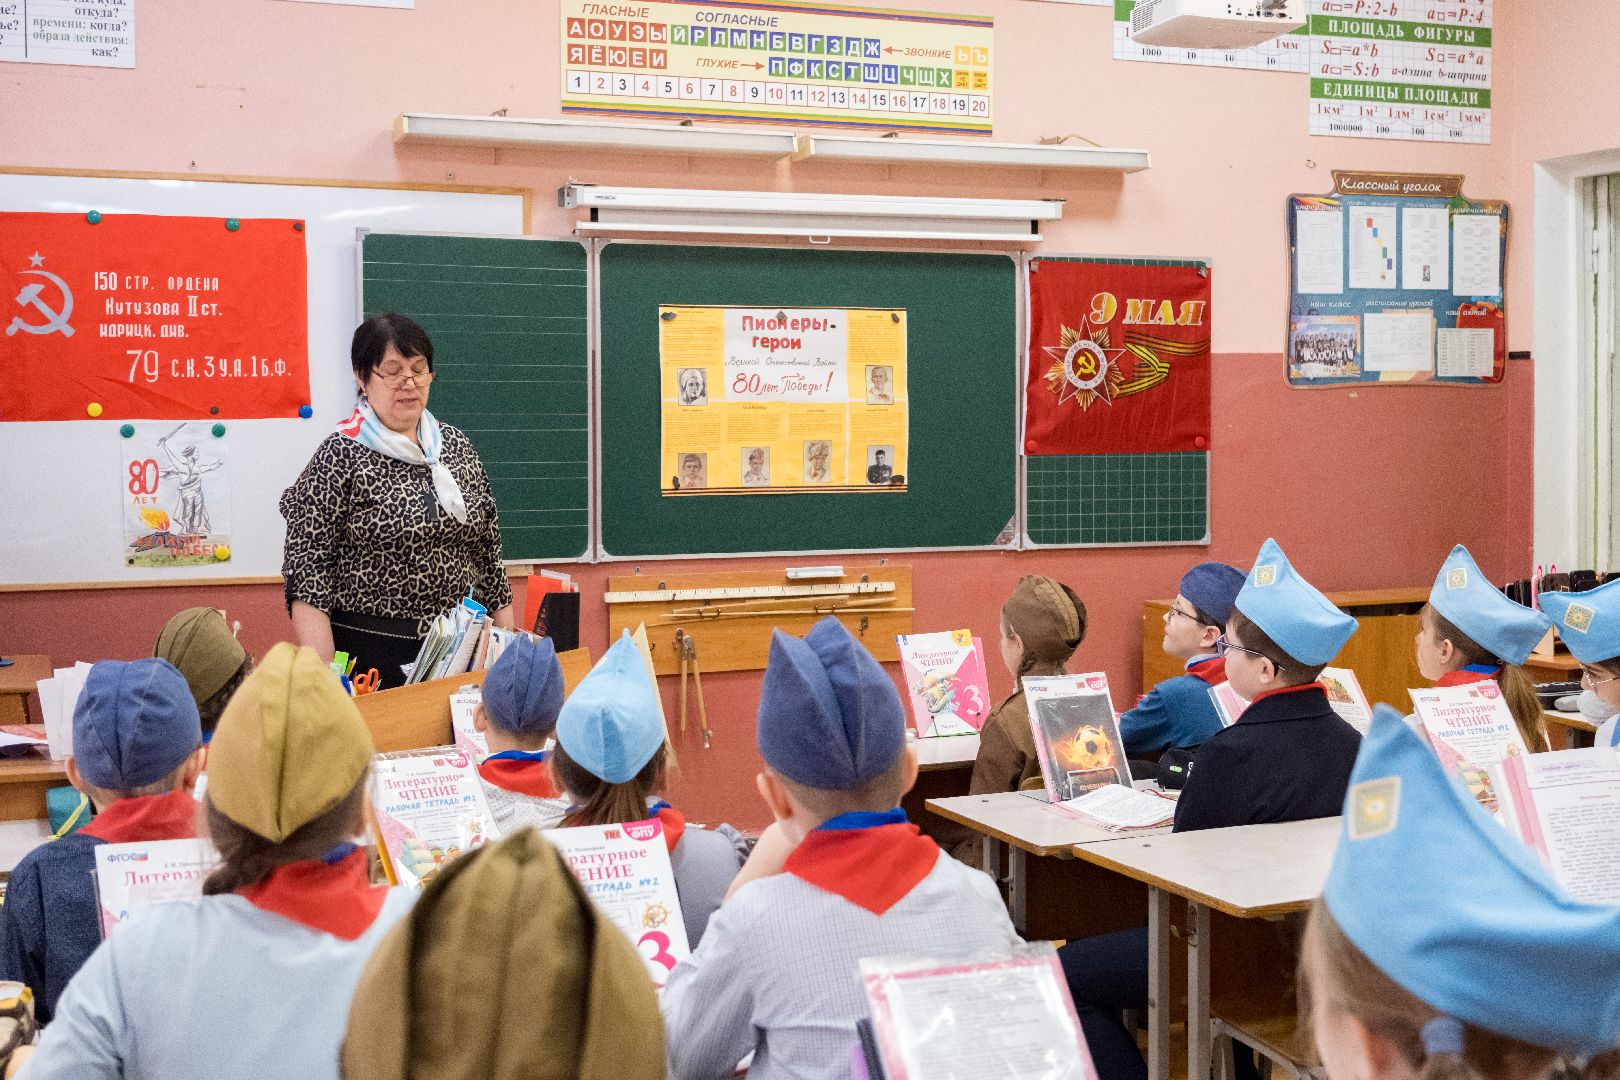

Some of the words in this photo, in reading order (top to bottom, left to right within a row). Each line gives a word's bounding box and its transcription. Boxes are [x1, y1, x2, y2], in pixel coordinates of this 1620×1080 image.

[75, 8, 119, 19] откуда?
[582, 4, 649, 18] ГЛАСНЫЕ
[33, 19, 86, 29] времени:
[90, 22, 128, 33] когда?
[696, 12, 778, 27] СОГЛАСНЫЕ
[33, 30, 70, 43] образа
[73, 35, 128, 45] действия:
[1328, 19, 1404, 38] ПЛОЩАДЬ
[1414, 27, 1475, 43] ФИГУРЫ
[92, 47, 119, 58] как?
[904, 47, 951, 59] ЗВОНКИЕ
[1142, 48, 1162, 56] 1000
[1224, 54, 1234, 62] 10
[1266, 57, 1276, 65] 10
[696, 58, 739, 69] ГЛУХИЕ
[575, 77, 581, 87] 1
[597, 78, 605, 89] 2
[619, 79, 627, 90] 3
[642, 81, 649, 92] 4
[664, 82, 672, 93] 5
[686, 83, 693, 94] 6
[709, 84, 716, 95] 7
[730, 86, 737, 96] 8
[751, 87, 758, 98] 9
[769, 88, 783, 99] 10
[790, 89, 803, 101] 11
[811, 91, 825, 102] 12
[831, 92, 845, 103] 13
[852, 93, 866, 104] 14
[873, 94, 886, 106] 15
[893, 96, 906, 107] 16
[913, 97, 926, 108] 17
[933, 98, 946, 109] 18
[953, 99, 966, 111] 19
[972, 100, 986, 111] 20
[1323, 82, 1399, 100] ЕДИНИЦЫ
[1404, 88, 1478, 105] ПЛОЩАДИ
[1376, 125, 1390, 134] 100
[1411, 127, 1425, 136] 100
[1449, 130, 1463, 138] 100
[1341, 177, 1400, 191] Классный
[1403, 183, 1441, 193] уголок
[94, 272, 118, 291] 150
[125, 275, 155, 291] СТР.
[168, 277, 220, 291] ОРДЕНА
[1089, 291, 1118, 325] 9
[1122, 298, 1206, 326] МАЯ
[100, 323, 156, 338] ИДРИЦК.
[160, 323, 189, 338] ДИВ.
[752, 336, 802, 353] герои
[126, 350, 159, 383] 79
[732, 372, 761, 394] 80
[757, 383, 779, 396] лет
[128, 459, 159, 495] 80
[133, 496, 159, 505] ЛЕТ
[963, 685, 984, 715] 3
[1432, 704, 1496, 717] Литературное
[1445, 714, 1493, 727] ЧТЕНИЕ
[1437, 729, 1465, 737] РАБОЧАЯ
[1466, 727, 1495, 736] ТЕТРАДЬ
[399, 784, 459, 800] ЧТЕНИЕ
[386, 802, 421, 813] РАБОЧАЯ
[425, 798, 459, 808] ТЕТРАДЬ
[569, 849, 647, 866] ратурное
[577, 863, 634, 881] ЕНИЕ
[587, 881, 632, 893] ЕТРАДЬ
